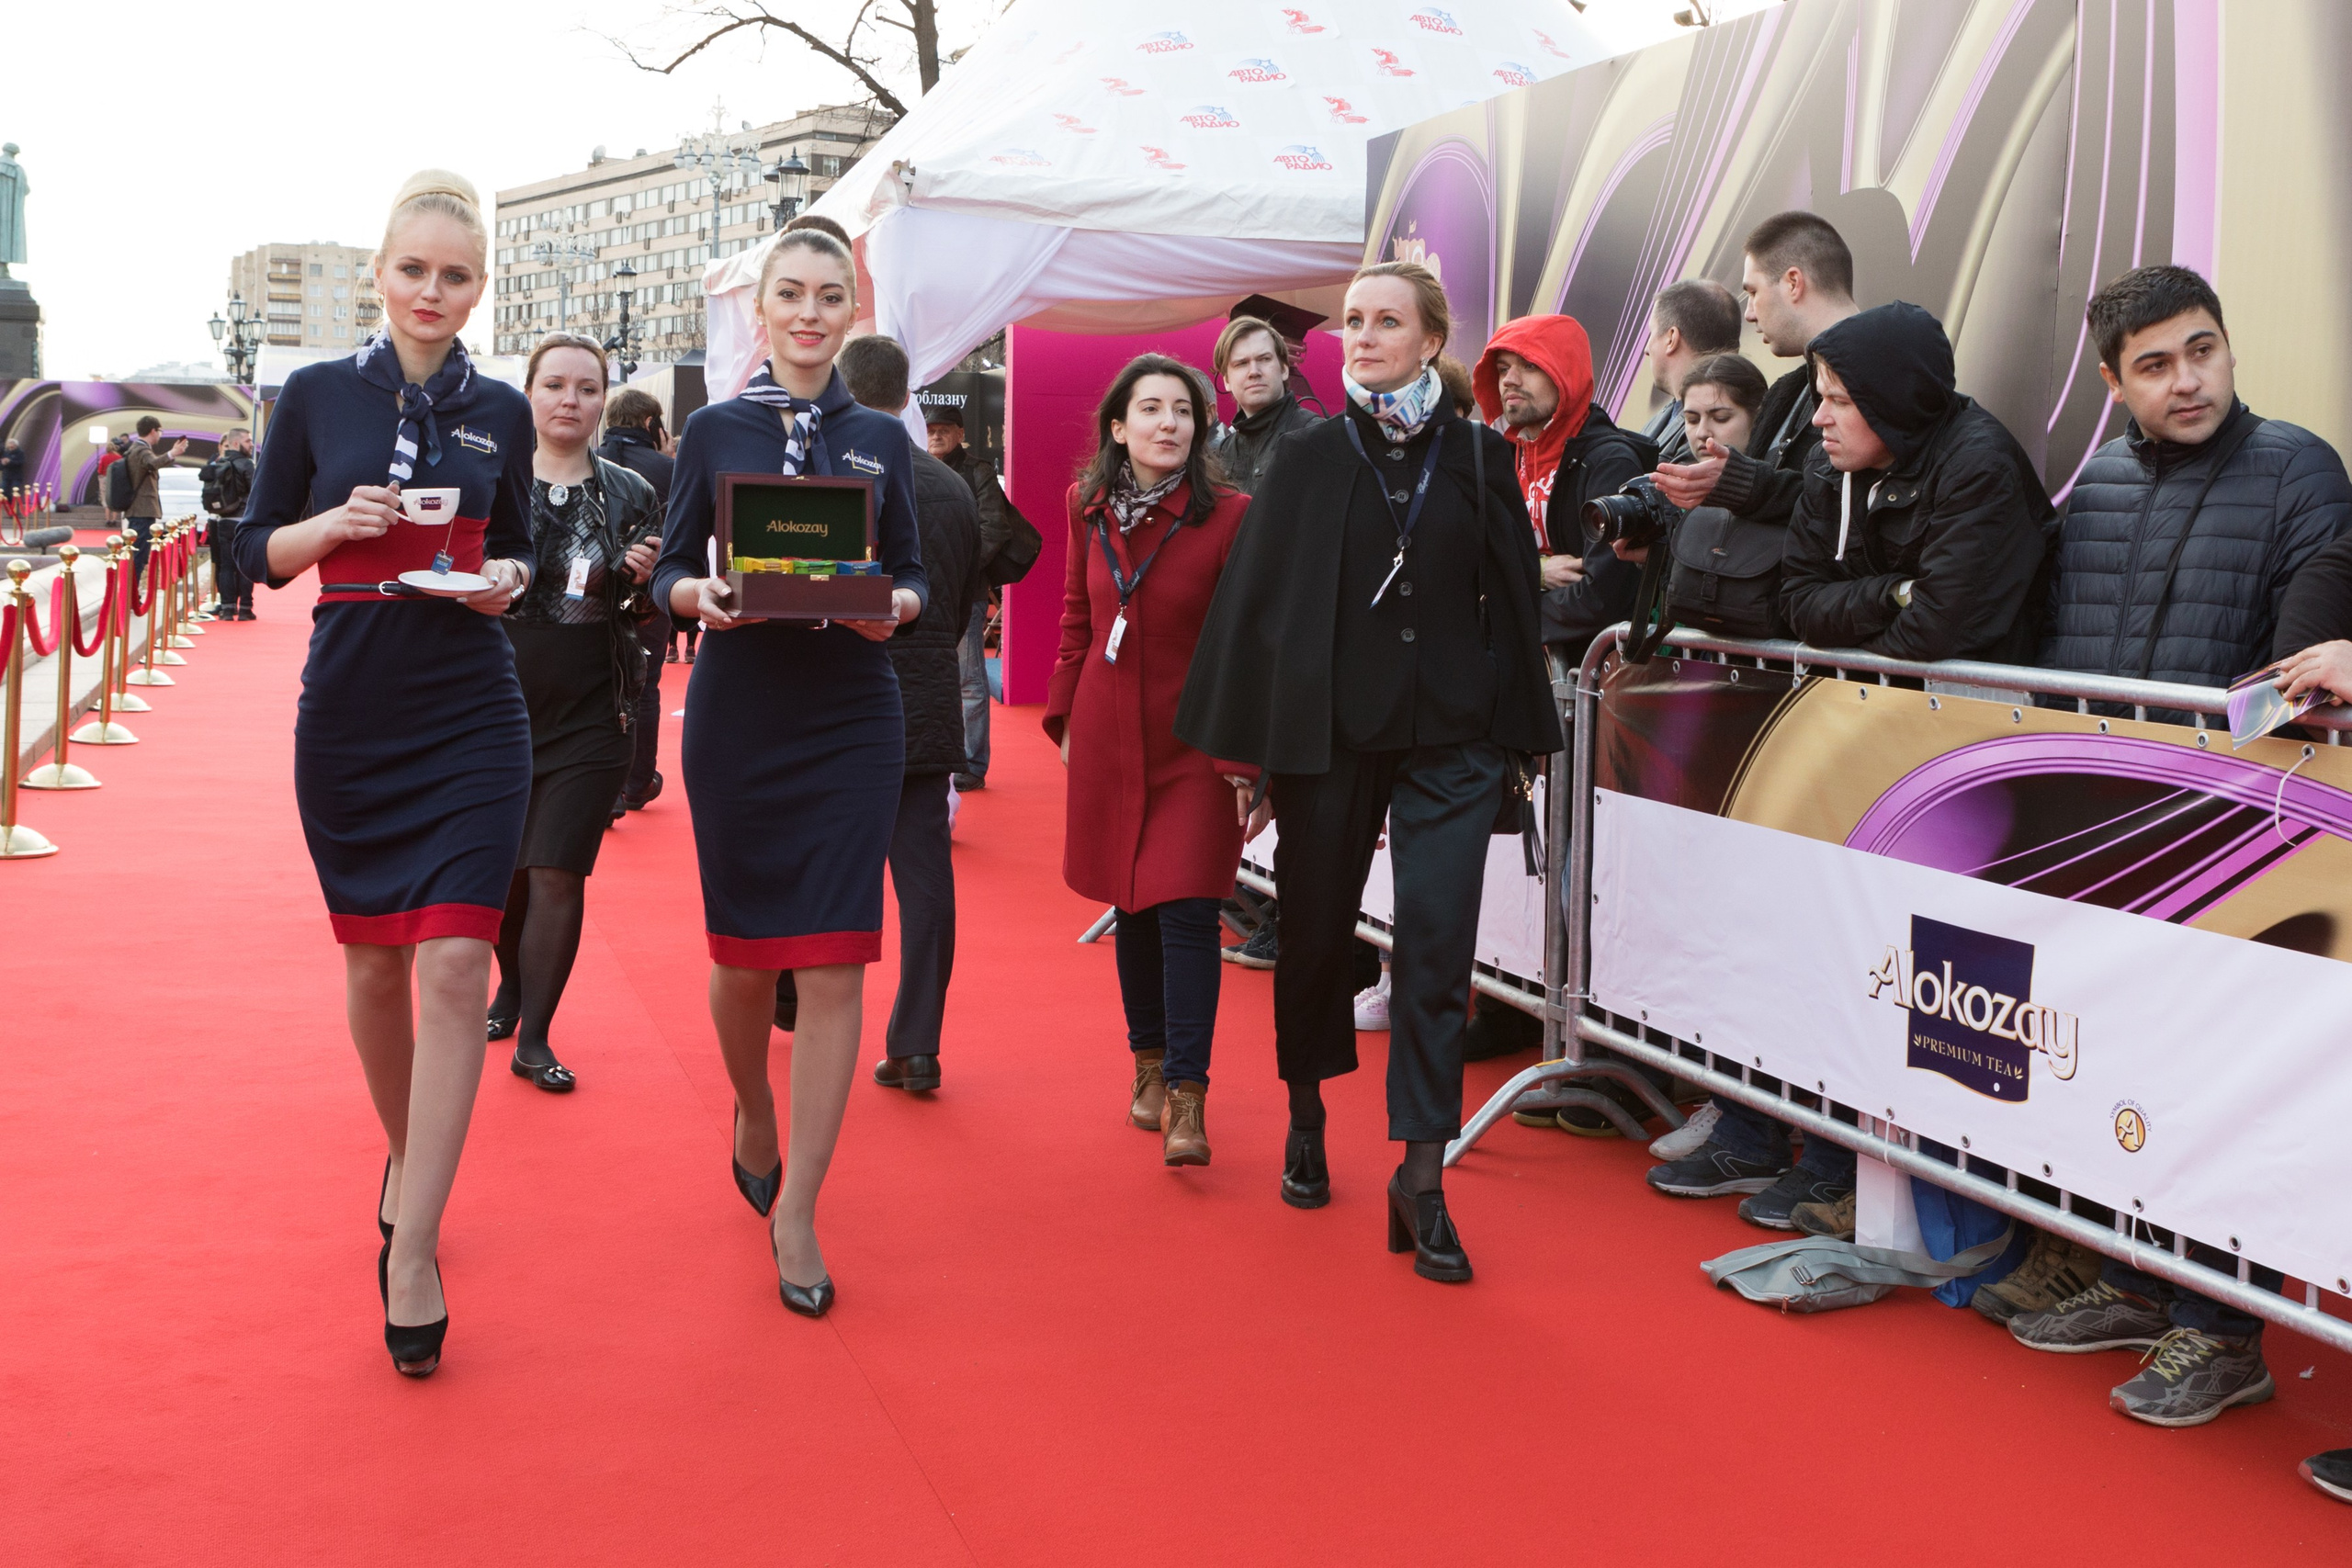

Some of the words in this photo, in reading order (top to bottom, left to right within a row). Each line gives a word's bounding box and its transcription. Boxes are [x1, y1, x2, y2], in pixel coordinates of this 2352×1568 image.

[1409, 15, 1442, 26] АВТО
[1420, 22, 1463, 36] РАДИО
[1136, 39, 1172, 51] АВТО
[1147, 43, 1194, 54] РАДИО
[1227, 68, 1263, 78] АВТО
[1240, 73, 1286, 83] РАДИО
[1492, 69, 1523, 80] АВТО
[1502, 76, 1534, 86] РАДИ
[1180, 115, 1216, 124] АВТО
[1192, 120, 1240, 129] РАДИО
[1273, 155, 1309, 164] АВТО
[1285, 163, 1332, 171] РАДИО
[450, 428, 498, 453] Alokozay
[842, 452, 885, 474] Alokozay
[765, 520, 829, 537] Alokozay
[1867, 944, 2079, 1081] Alokozay
[1922, 1035, 1983, 1066] PREMIUM
[1985, 1055, 2013, 1077] TEA
[2109, 1100, 2126, 1120] SYMBOL
[2135, 1103, 2152, 1133] QUALITY
